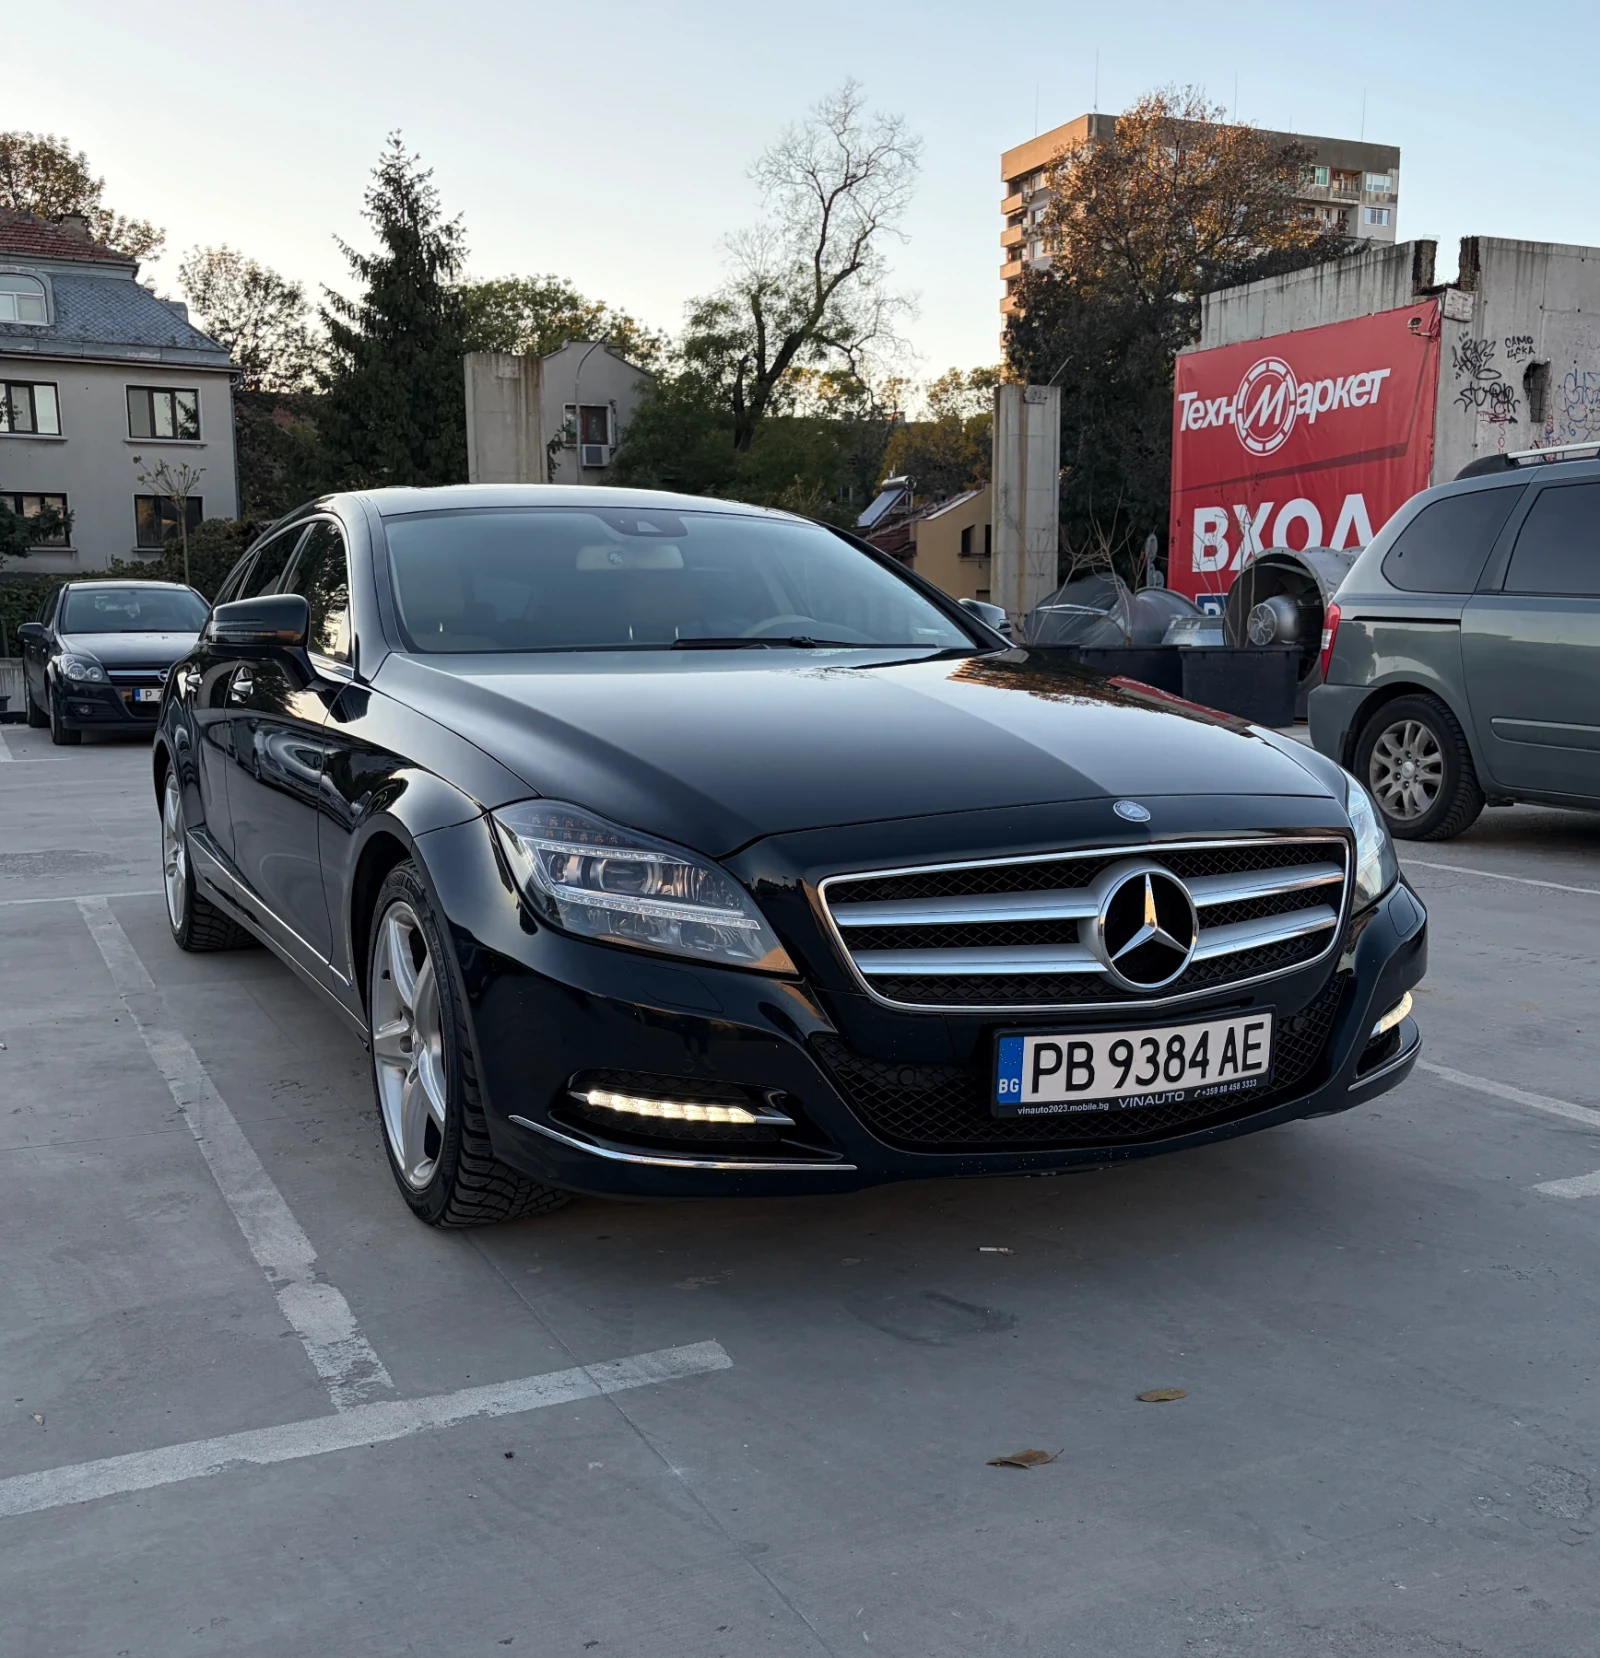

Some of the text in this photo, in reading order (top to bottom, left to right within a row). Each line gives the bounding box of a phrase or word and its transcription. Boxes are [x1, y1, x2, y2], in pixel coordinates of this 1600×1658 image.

[1031, 1021, 1265, 1094] PB 9384 AE
[999, 1078, 1019, 1094] BG
[1118, 1090, 1185, 1108] VINAUTO
[1017, 1102, 1110, 1115] vinauto2023.mobile.bg
